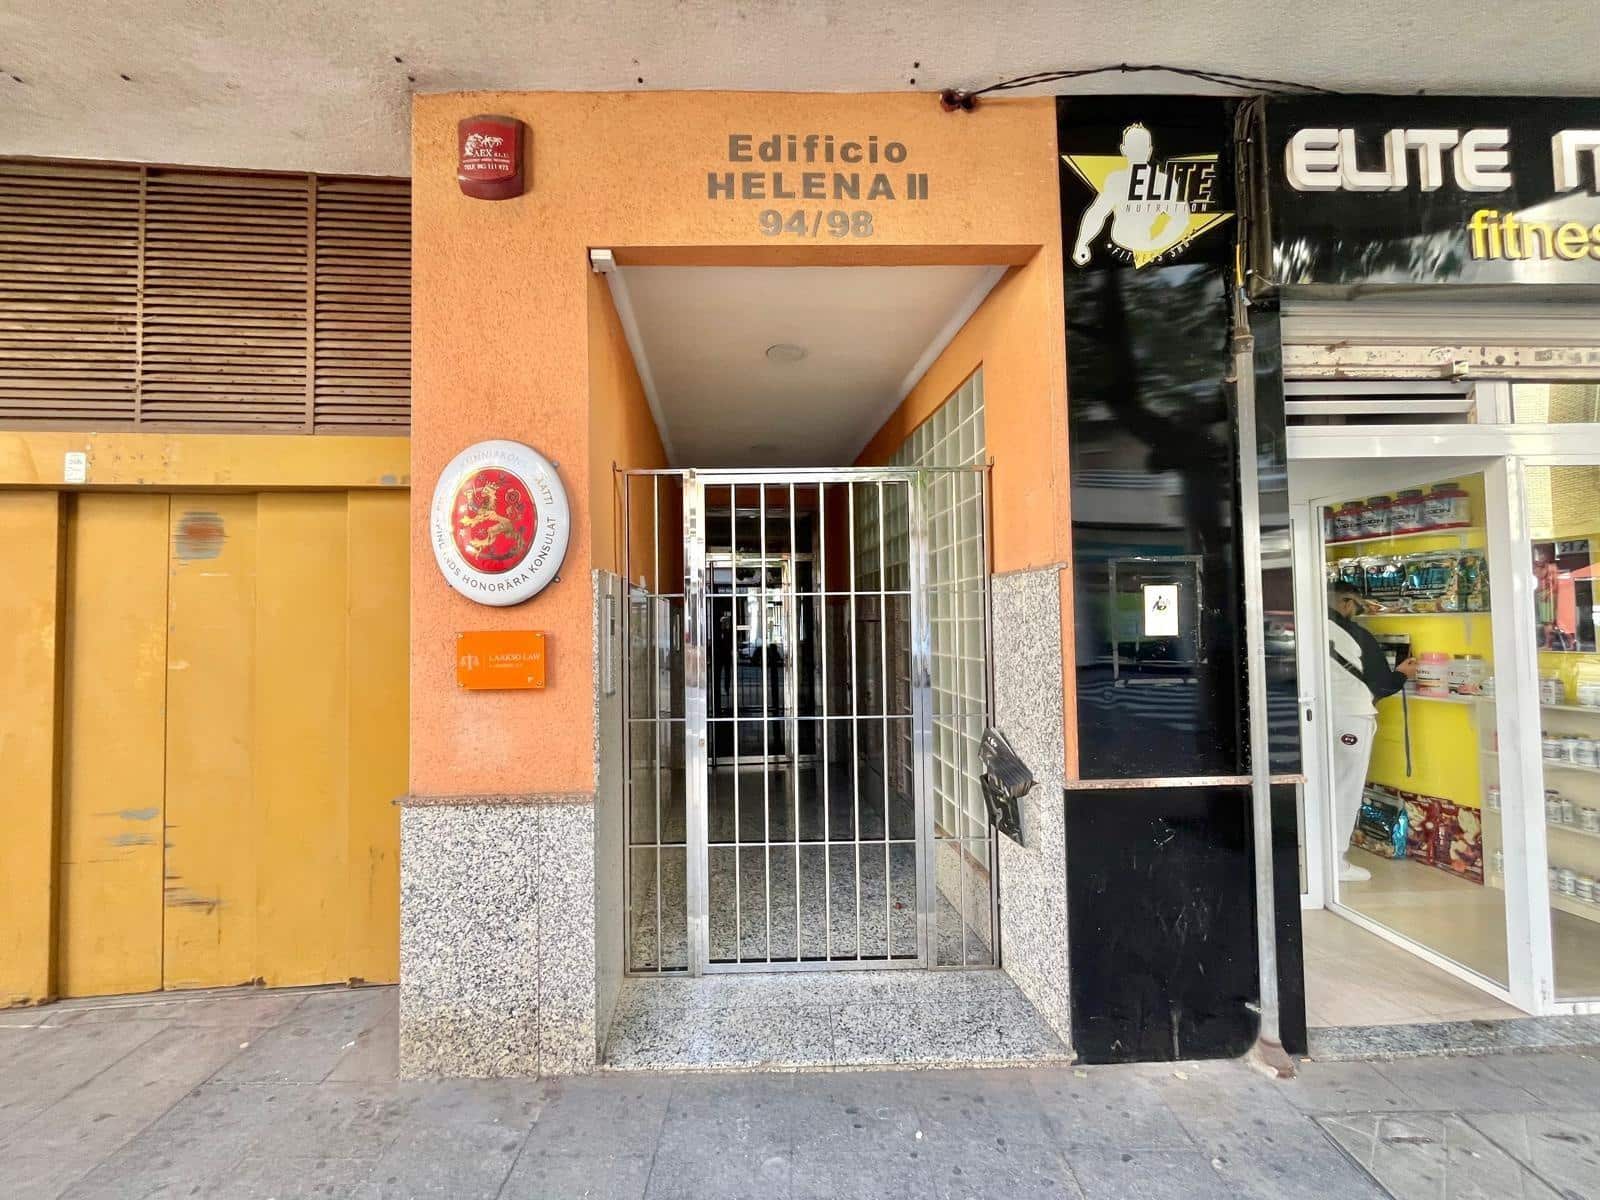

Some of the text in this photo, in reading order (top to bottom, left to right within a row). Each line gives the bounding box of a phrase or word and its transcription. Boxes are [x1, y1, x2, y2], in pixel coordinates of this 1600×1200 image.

[728, 134, 907, 163] Edificio
[1285, 128, 1512, 192] ELITE
[707, 172, 929, 200] HELENA II
[1128, 161, 1217, 203] ELITE
[1125, 203, 1207, 212] NUTRITION
[758, 208, 874, 238] 94/98
[530, 516, 557, 574] KONSULAT
